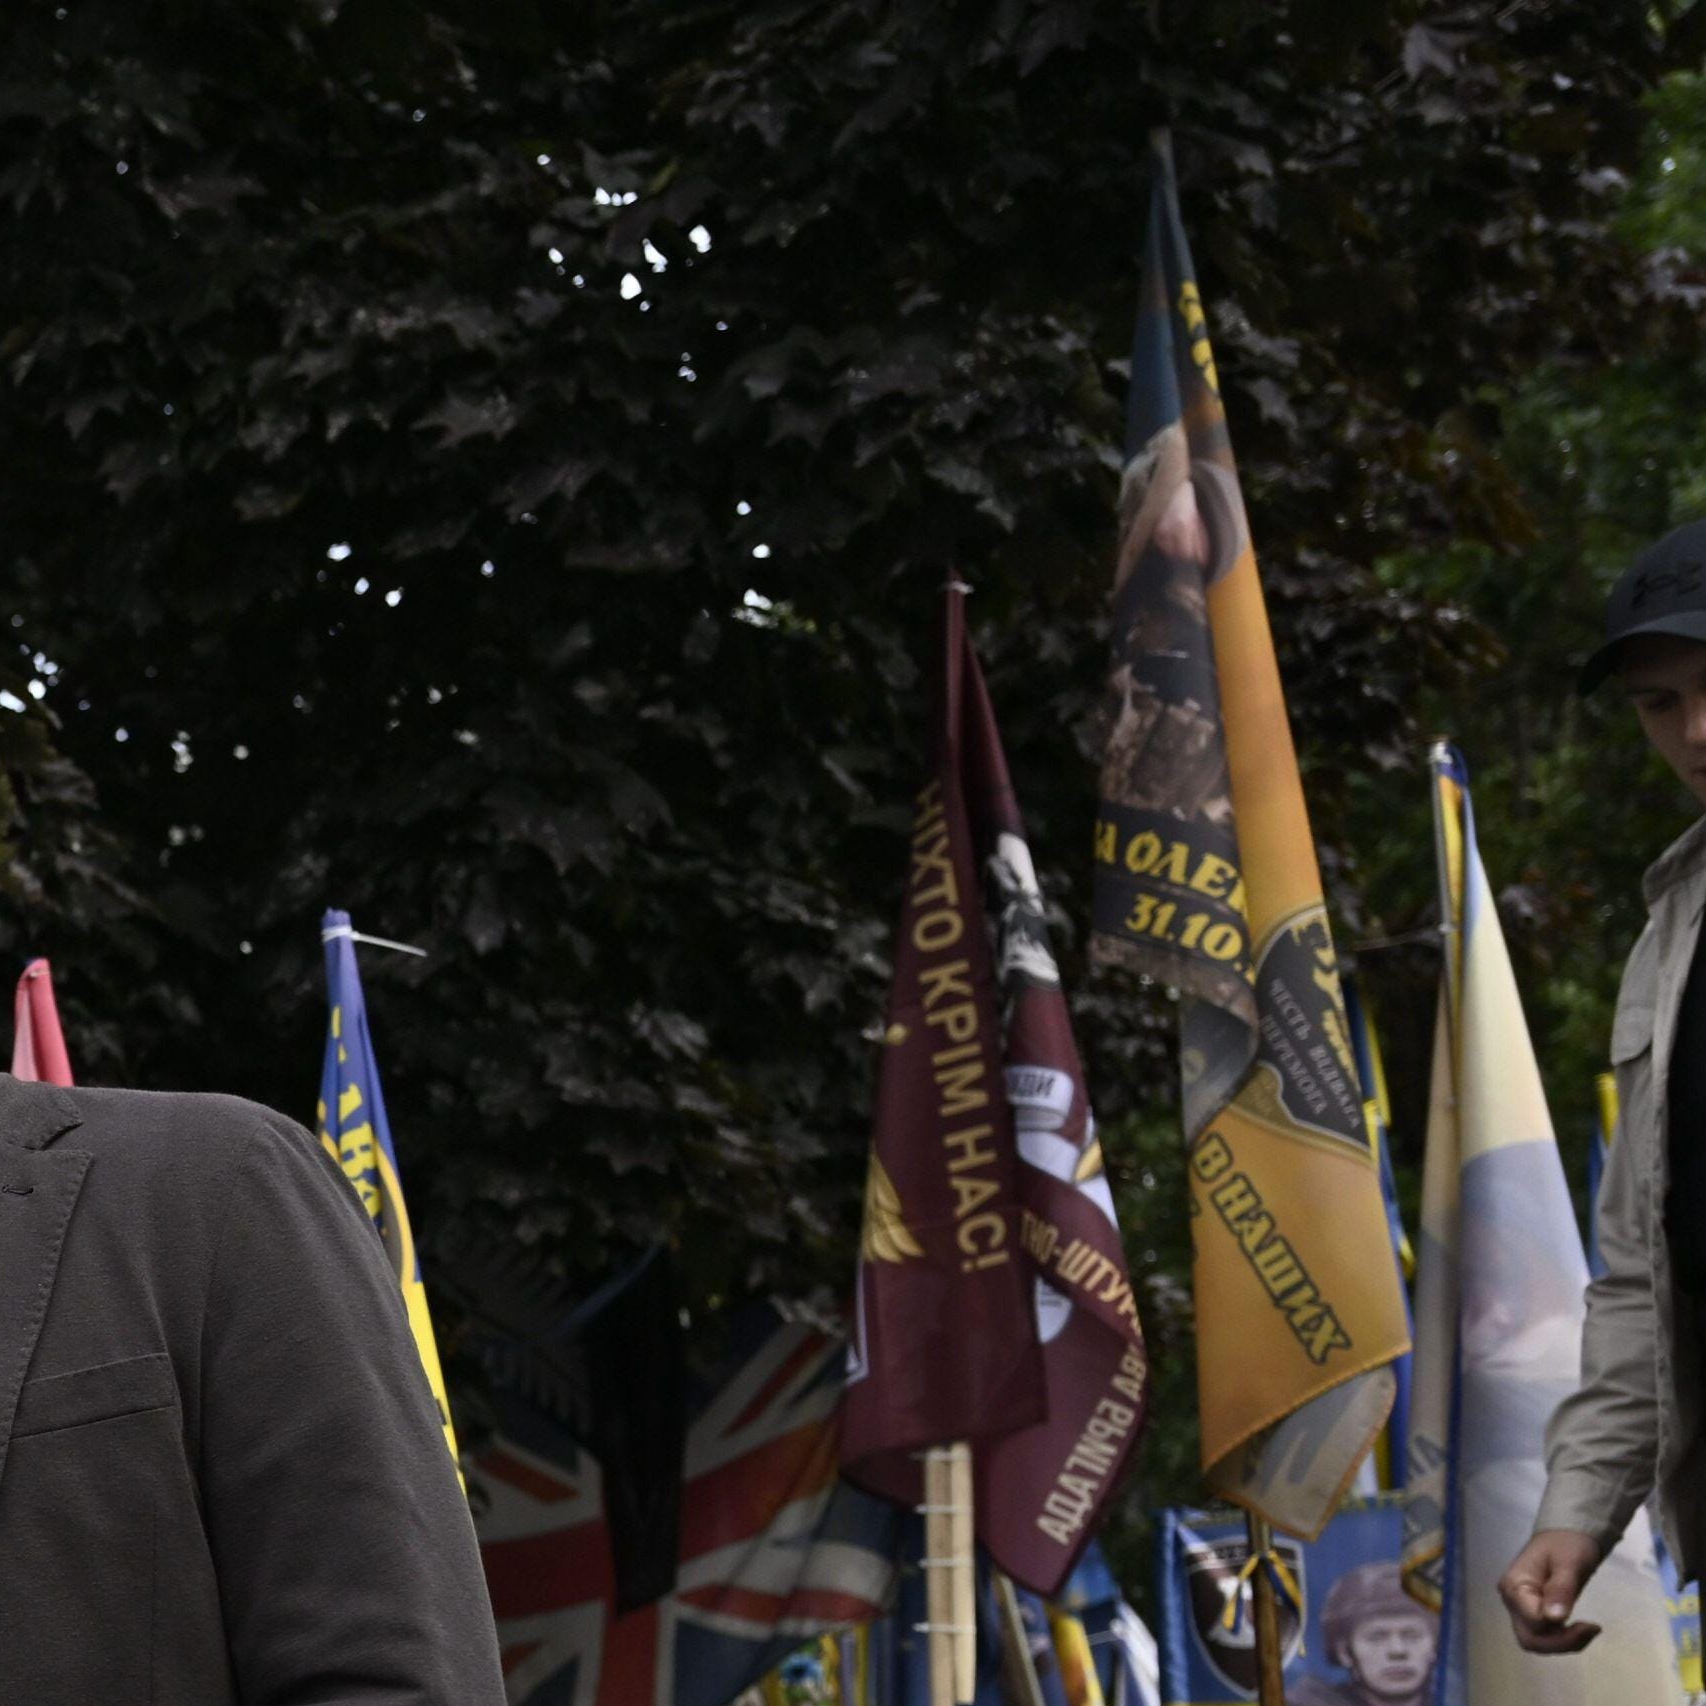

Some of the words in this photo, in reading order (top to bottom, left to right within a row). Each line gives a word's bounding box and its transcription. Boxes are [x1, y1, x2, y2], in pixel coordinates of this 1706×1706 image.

[910, 779, 965, 952] НІХТО
[919, 959, 990, 1118] КРІМ
[1309, 1044, 1361, 1128] ВІДВАГА
[943, 1124, 1010, 1274] НАС!
[1190, 1130, 1235, 1184] В
[1210, 1172, 1353, 1366] НАШИХ
